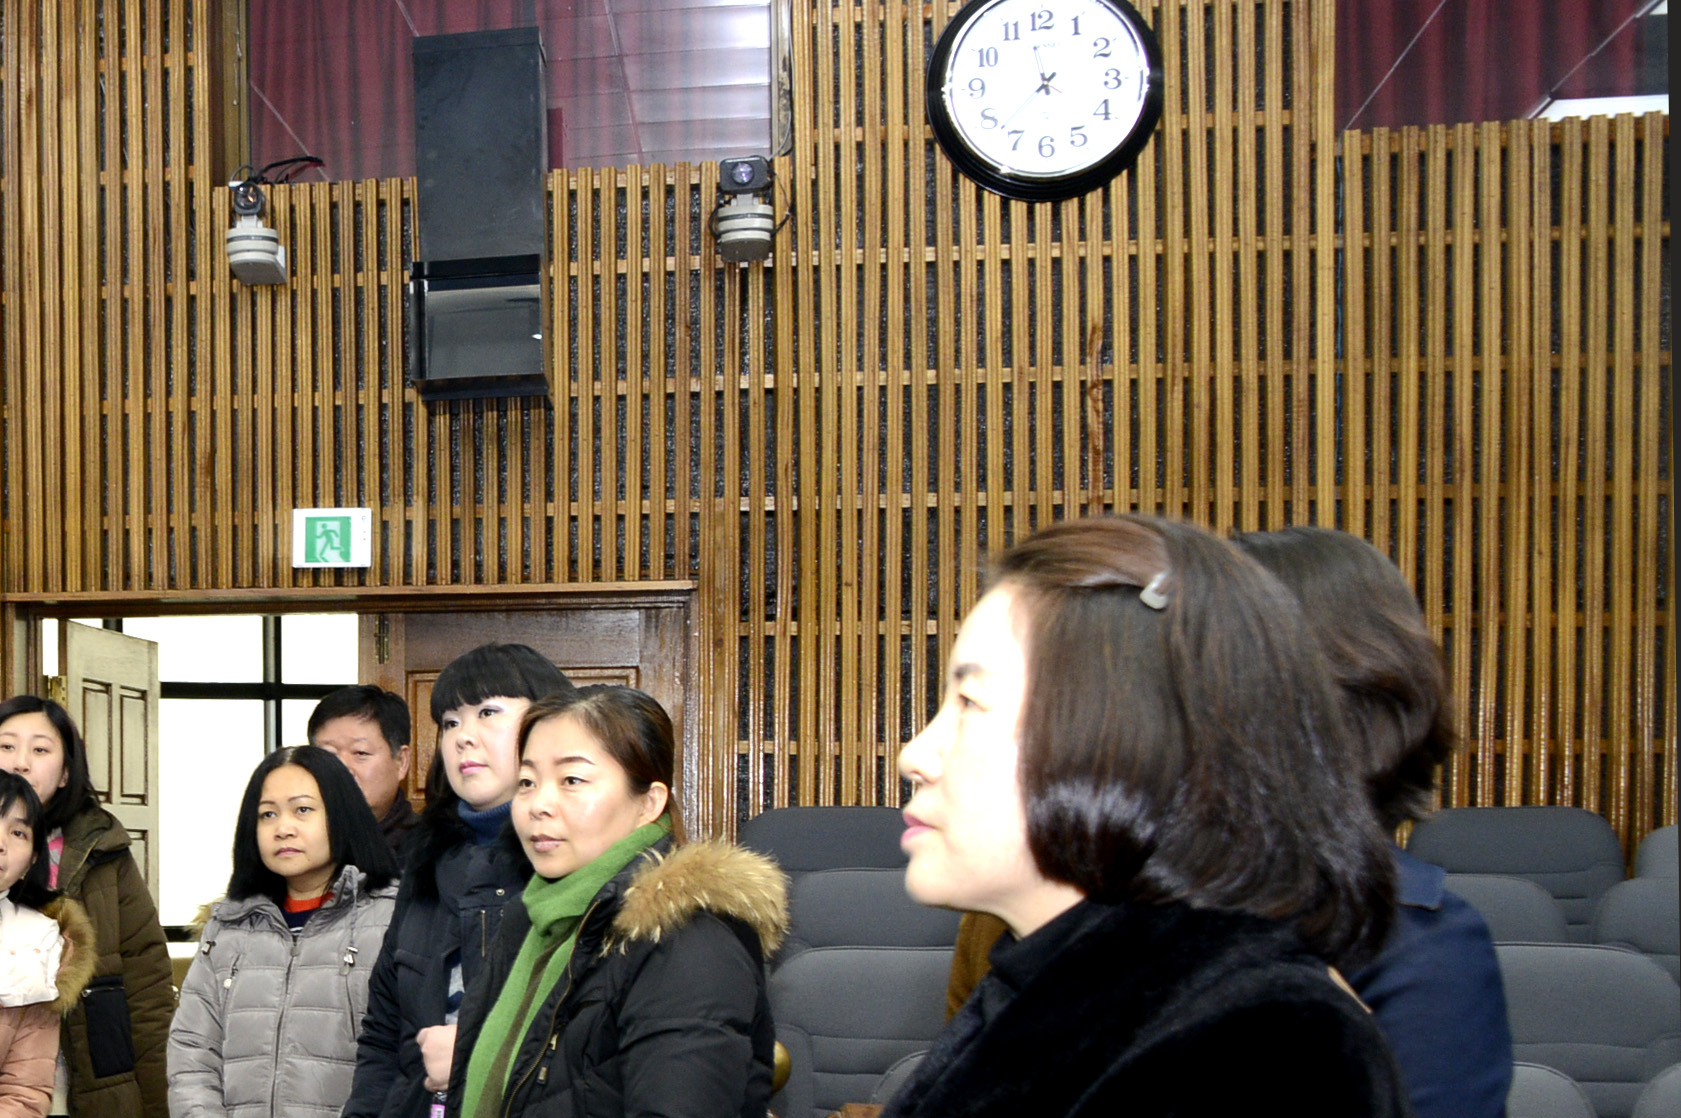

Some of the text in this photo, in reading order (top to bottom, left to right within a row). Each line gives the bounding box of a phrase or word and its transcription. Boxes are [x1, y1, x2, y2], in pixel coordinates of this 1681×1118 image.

[1003, 20, 1021, 41] 11
[1030, 9, 1055, 31] 12
[1071, 15, 1082, 36] 1
[978, 46, 999, 68] 10
[1092, 37, 1112, 58] 2
[968, 78, 986, 99] 9
[1103, 68, 1122, 89] 3
[980, 108, 999, 129] 8
[1092, 99, 1112, 121] 4
[1007, 129, 1025, 151] 7
[1070, 125, 1088, 147] 5
[1038, 136, 1055, 158] 6
